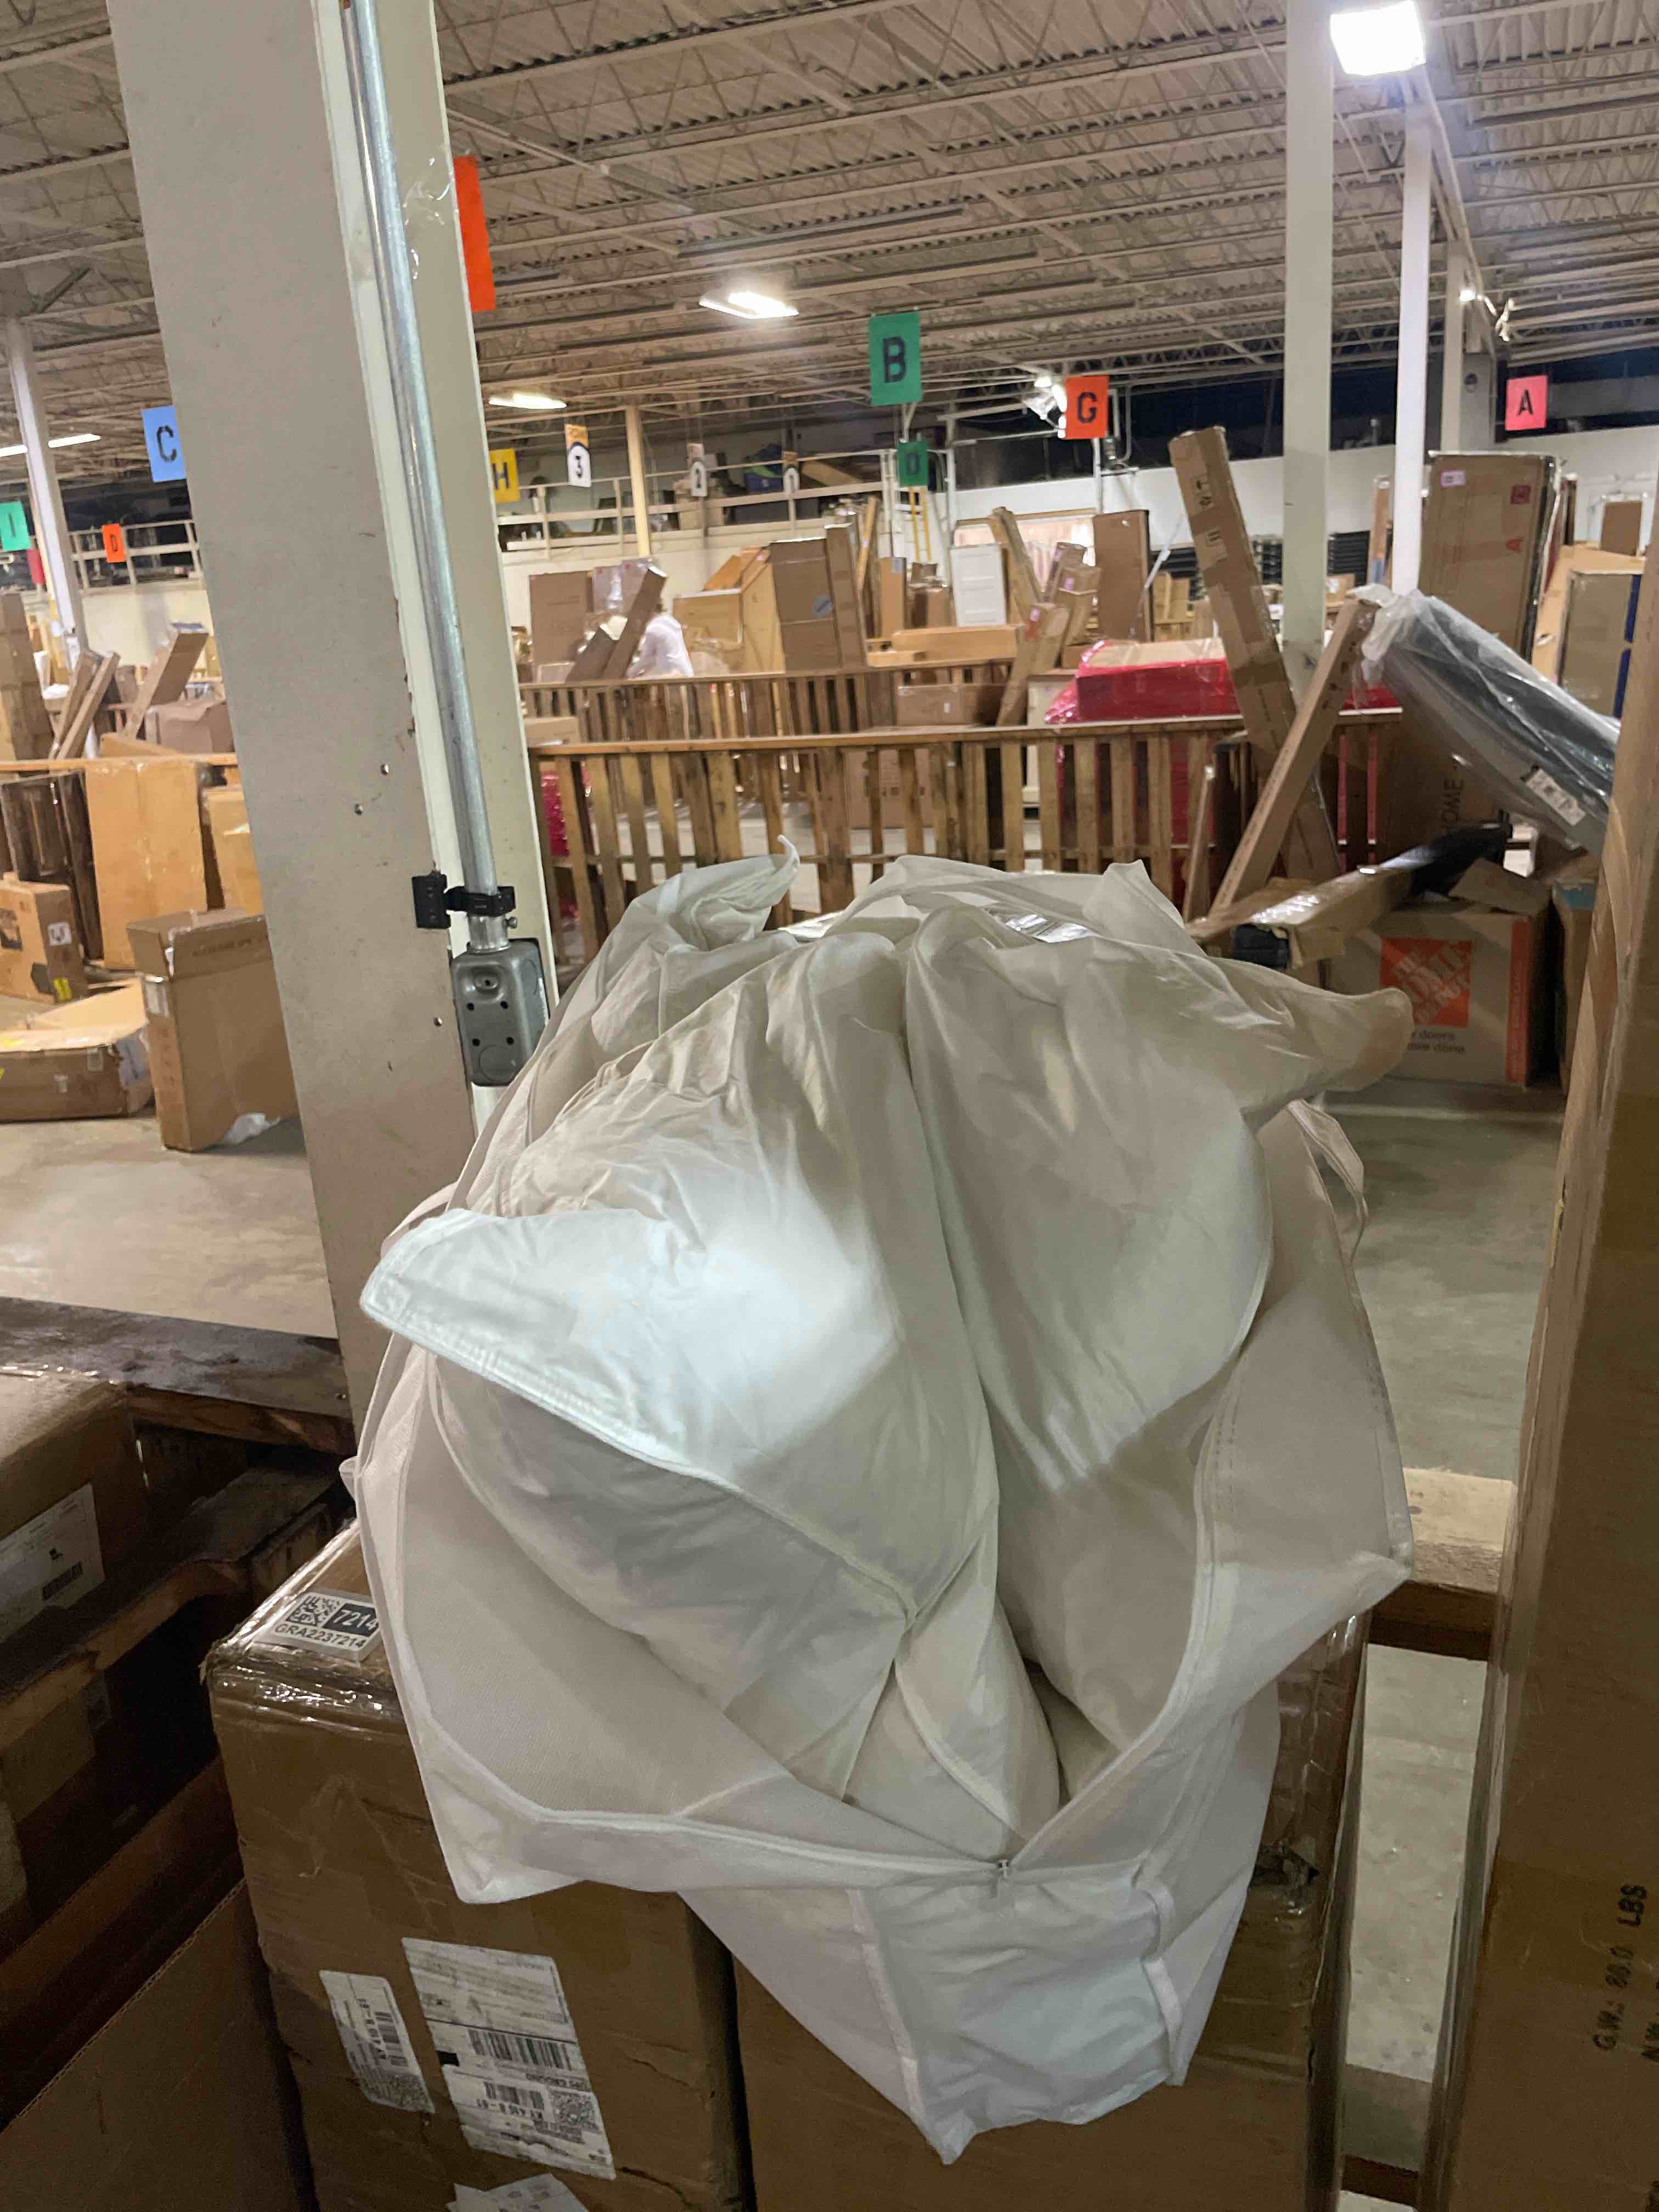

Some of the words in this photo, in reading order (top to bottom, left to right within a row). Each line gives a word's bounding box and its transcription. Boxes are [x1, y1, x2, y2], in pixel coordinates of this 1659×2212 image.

[883, 336, 906, 383] B
[1077, 392, 1097, 424] G
[1516, 389, 1533, 417] A
[157, 425, 177, 462] C
[492, 462, 509, 490] H
[334, 1609, 379, 1630] 7214
[275, 1623, 367, 1647] GRA2237214
[1617, 1884, 1647, 1927] LBS
